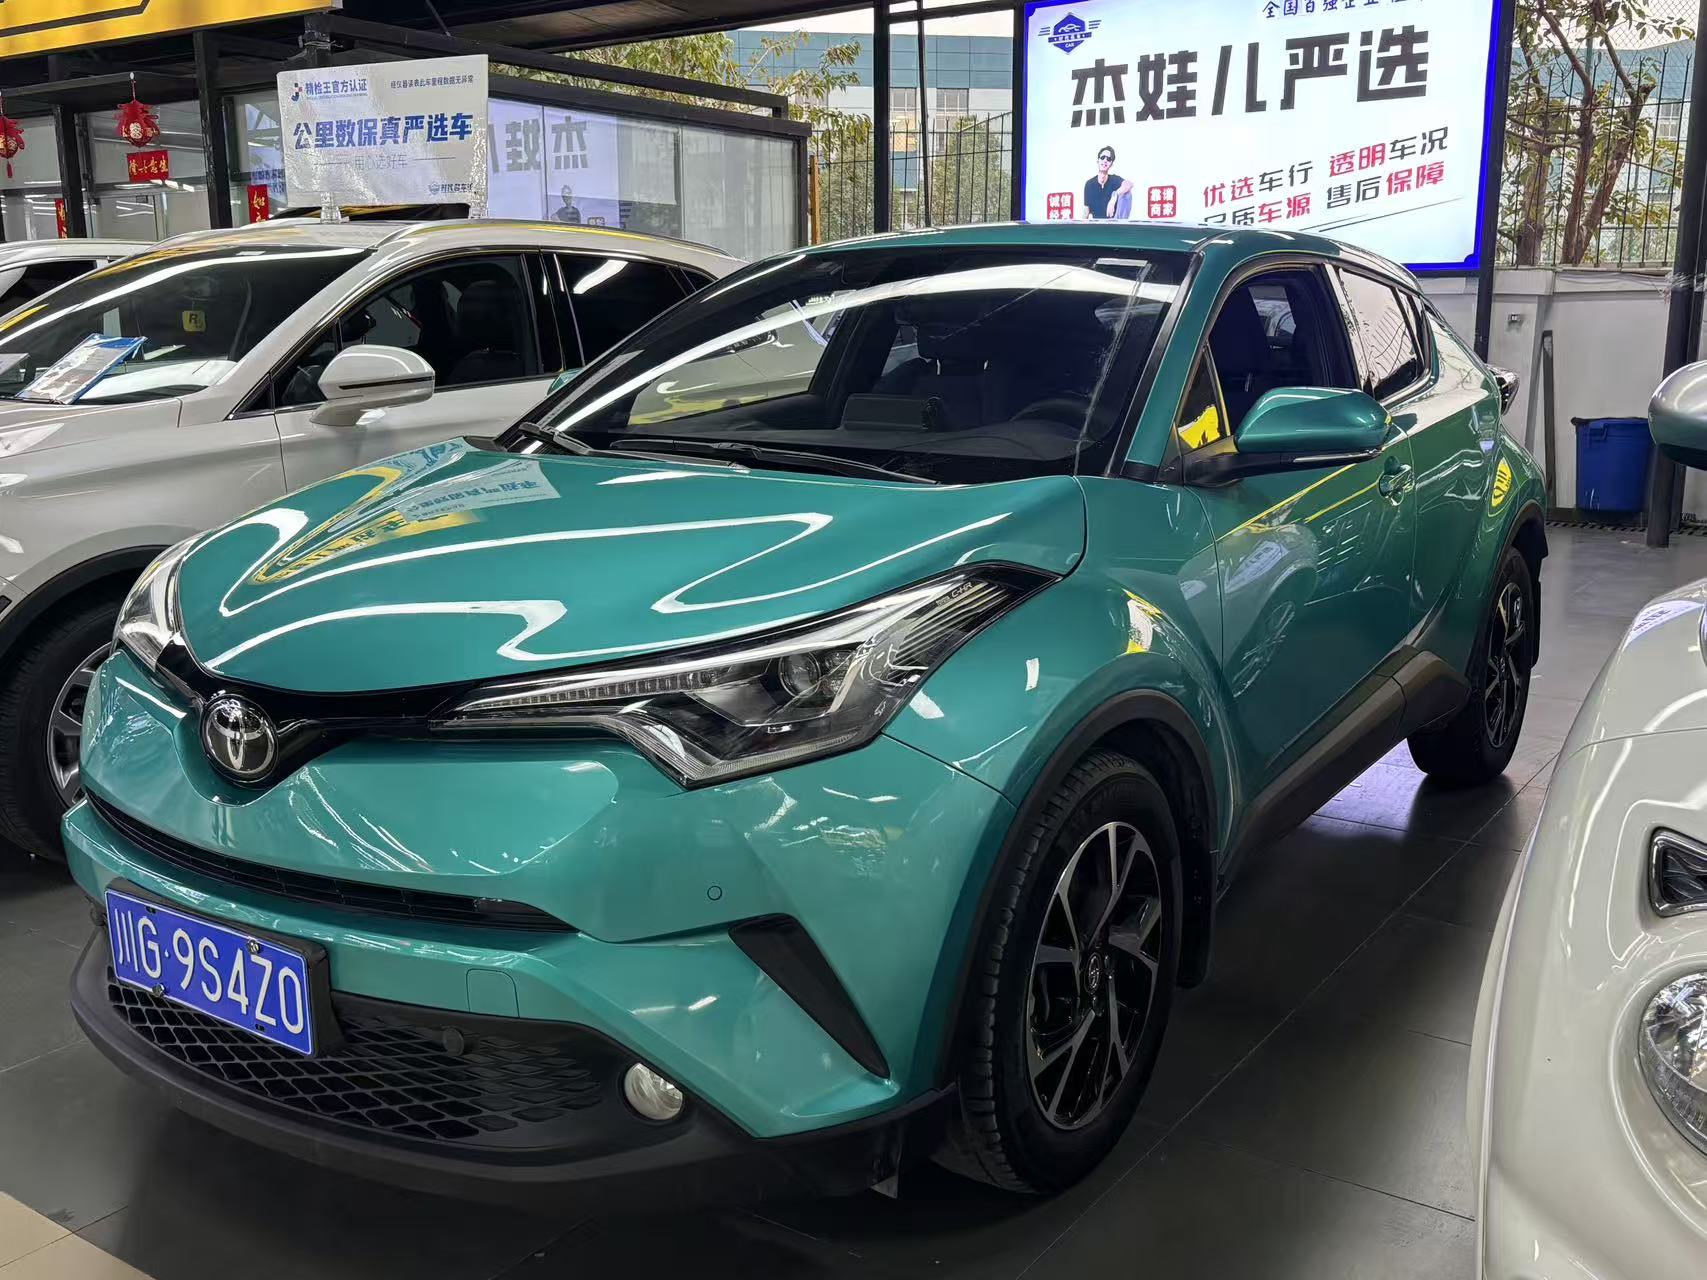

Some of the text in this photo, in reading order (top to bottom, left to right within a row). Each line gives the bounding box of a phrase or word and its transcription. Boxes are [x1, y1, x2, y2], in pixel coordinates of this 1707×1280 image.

[305, 78, 368, 96] 精检王官方认证
[1071, 24, 1429, 128] 杰娃儿严选
[293, 112, 474, 149] 公里数保真严选车
[1329, 127, 1448, 178] 透明车况
[1203, 160, 1313, 208] 优选车行
[1327, 161, 1444, 209] 售后保障
[114, 908, 304, 1035] 川G·9S4Z0
